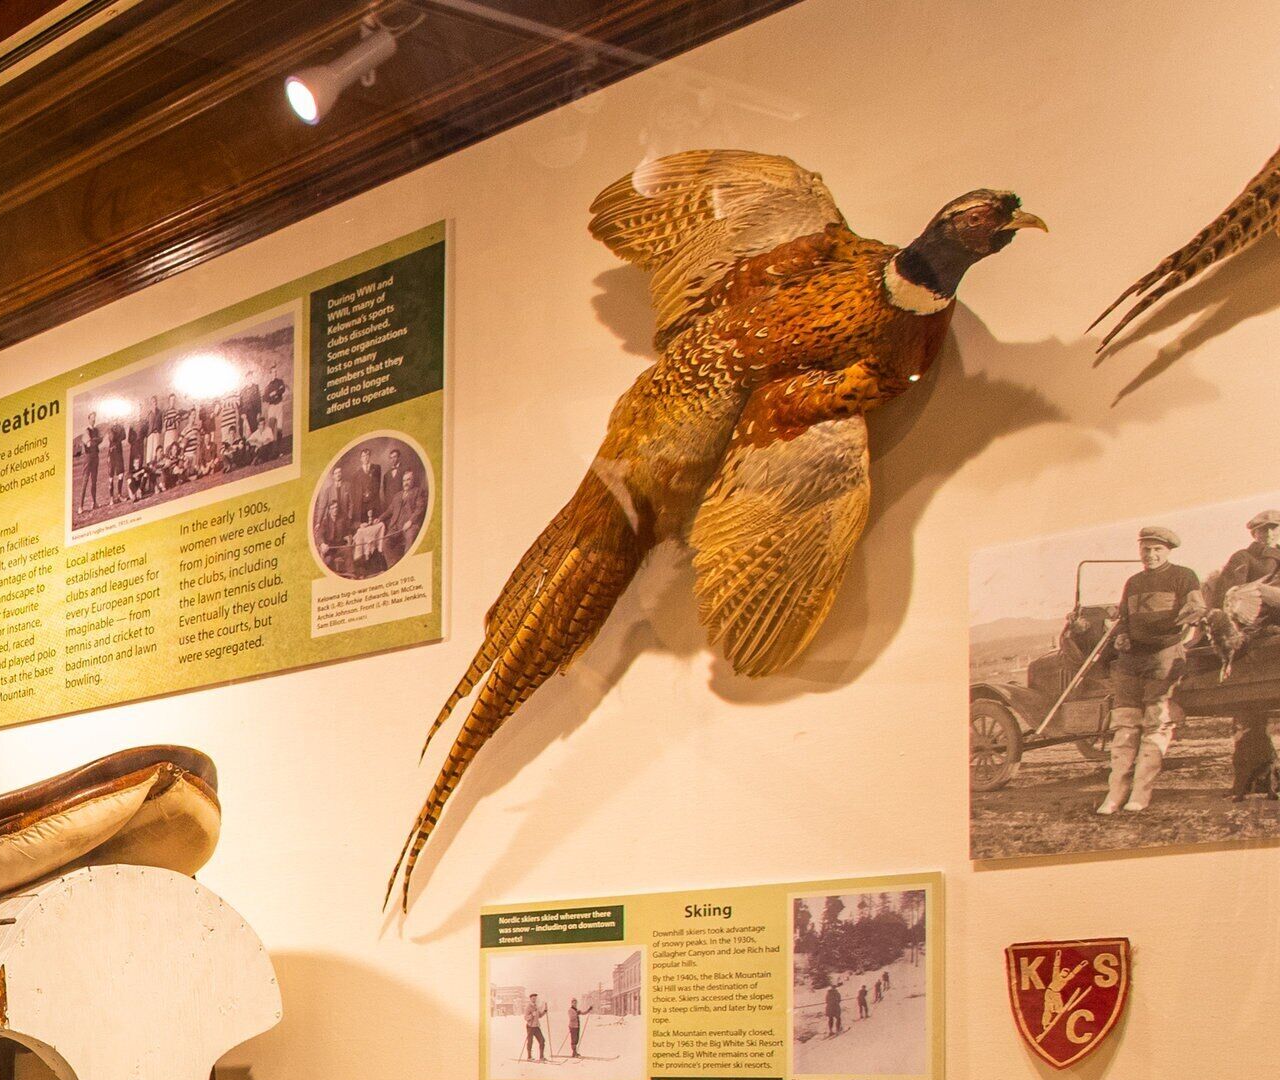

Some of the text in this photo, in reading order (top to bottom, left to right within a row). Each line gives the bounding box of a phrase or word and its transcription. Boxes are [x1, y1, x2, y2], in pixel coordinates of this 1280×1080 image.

[13, 438, 47, 455] defining
[0, 466, 8, 477] of
[9, 453, 49, 473] Kelowna's
[0, 479, 18, 493] both
[20, 472, 37, 488] past
[38, 465, 55, 479] and
[180, 503, 270, 535] In the early 1900s,
[179, 514, 295, 553] women were excluded
[179, 535, 285, 571] from joining some of
[179, 558, 278, 590] the clubs, including
[179, 576, 283, 609] the lawn tennis club.
[178, 592, 288, 627] Eventually they could
[178, 616, 272, 645] use the courts, but
[178, 638, 264, 663] were segregated.
[498, 916, 520, 924] Nordic
[540, 913, 559, 921] skied
[559, 912, 591, 920] wherever
[591, 910, 611, 918] there
[684, 903, 732, 919] Skiing
[535, 923, 567, 931] including
[652, 928, 684, 937] Downhill
[707, 926, 725, 934] took
[725, 925, 765, 933] advantage
[651, 939, 660, 948] of
[718, 936, 731, 944] the
[651, 950, 686, 959] Gallagher
[687, 949, 715, 957] Canyon
[716, 947, 731, 955] and
[746, 945, 763, 953] Rich
[764, 945, 780, 953] had
[1019, 952, 1119, 991] K S
[1066, 1009, 1095, 1044] C
